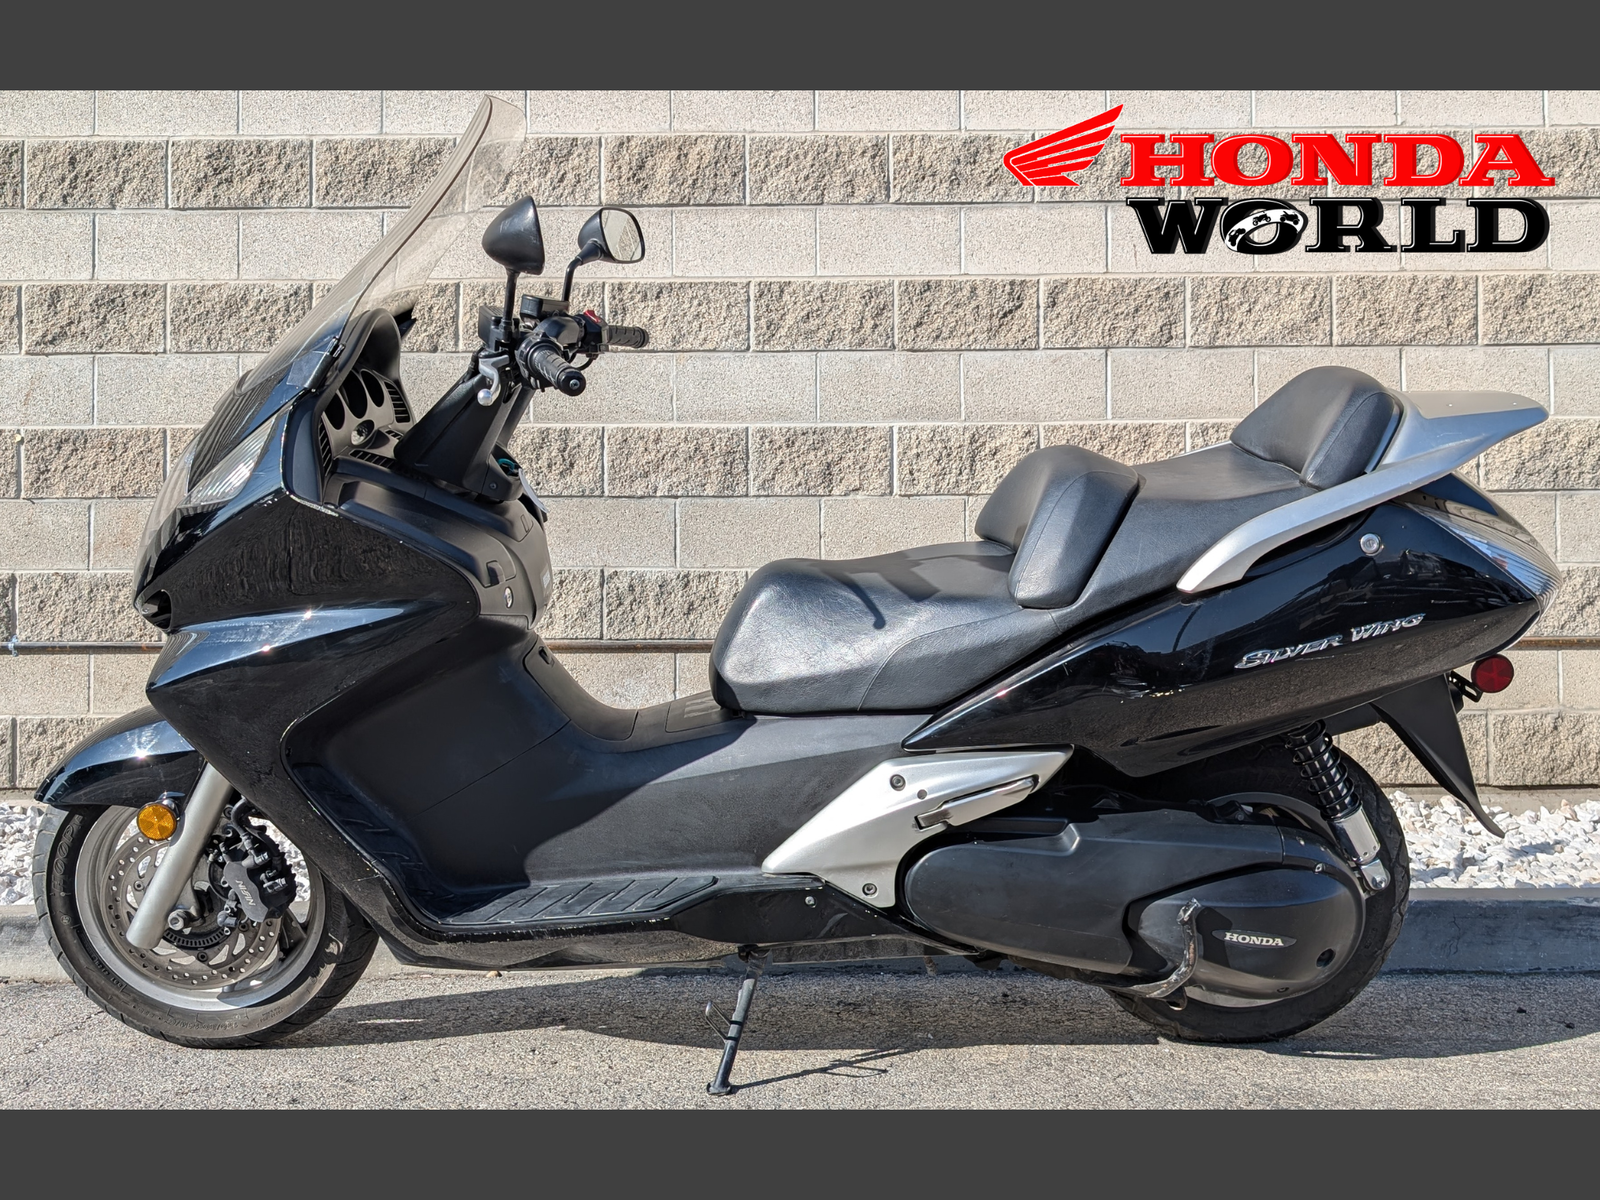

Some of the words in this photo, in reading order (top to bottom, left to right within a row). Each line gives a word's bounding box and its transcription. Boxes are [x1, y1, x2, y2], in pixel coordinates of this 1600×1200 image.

[1234, 635, 1343, 669] SILVER
[1351, 613, 1426, 641] WING
[235, 880, 256, 906] NISSIN
[1224, 932, 1284, 946] HONDA
